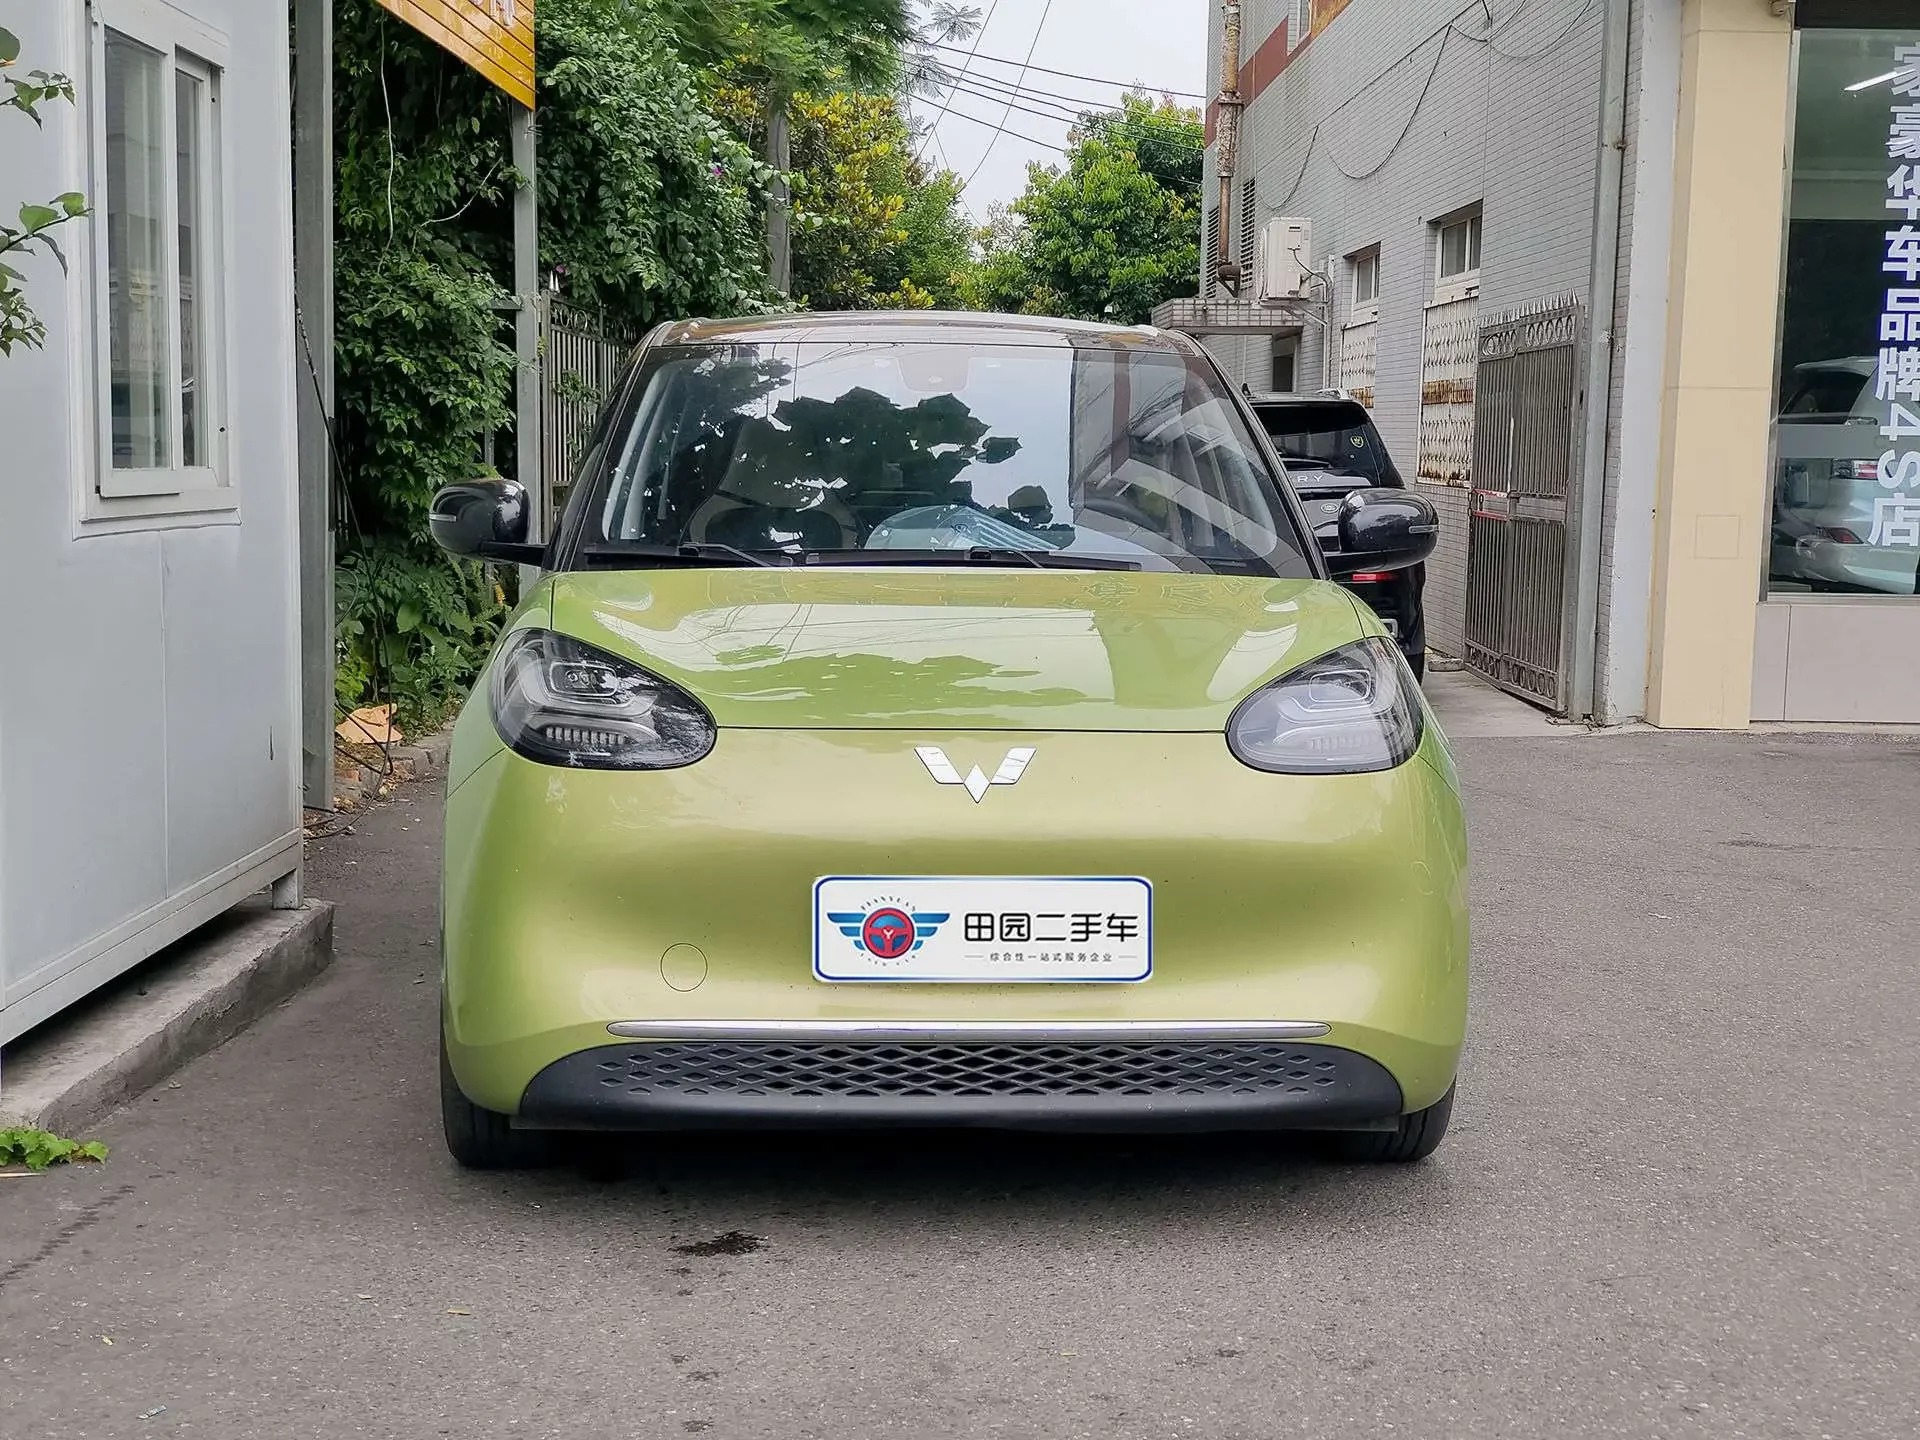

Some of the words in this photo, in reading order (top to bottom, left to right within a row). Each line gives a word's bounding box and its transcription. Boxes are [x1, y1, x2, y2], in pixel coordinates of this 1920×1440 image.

[964, 912, 1139, 942] 田园二手车
[989, 952, 1112, 963] 综合性一站式服务企业
